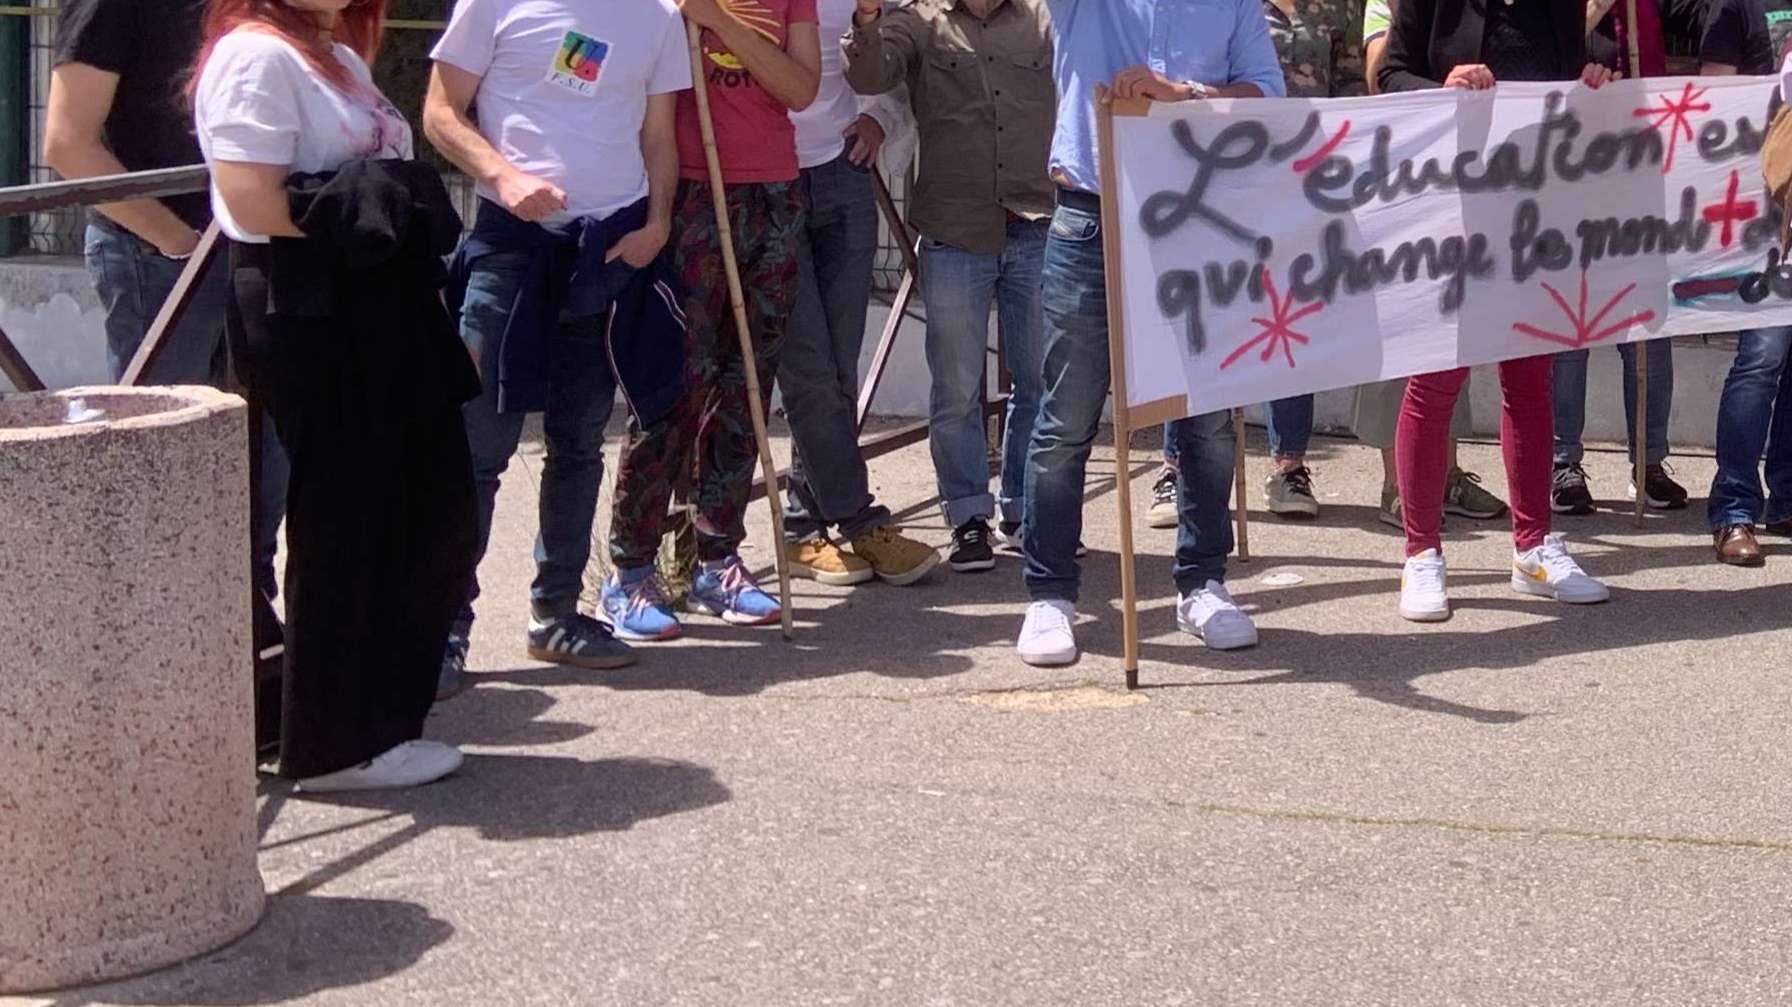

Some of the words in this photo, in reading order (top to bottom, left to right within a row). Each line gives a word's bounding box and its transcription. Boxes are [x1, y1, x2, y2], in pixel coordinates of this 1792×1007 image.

[1138, 90, 1664, 241] L'éducation
[1156, 235, 1274, 356] qui
[1288, 218, 1496, 318] change
[1510, 198, 1573, 284] le
[1577, 186, 1712, 271] monde
